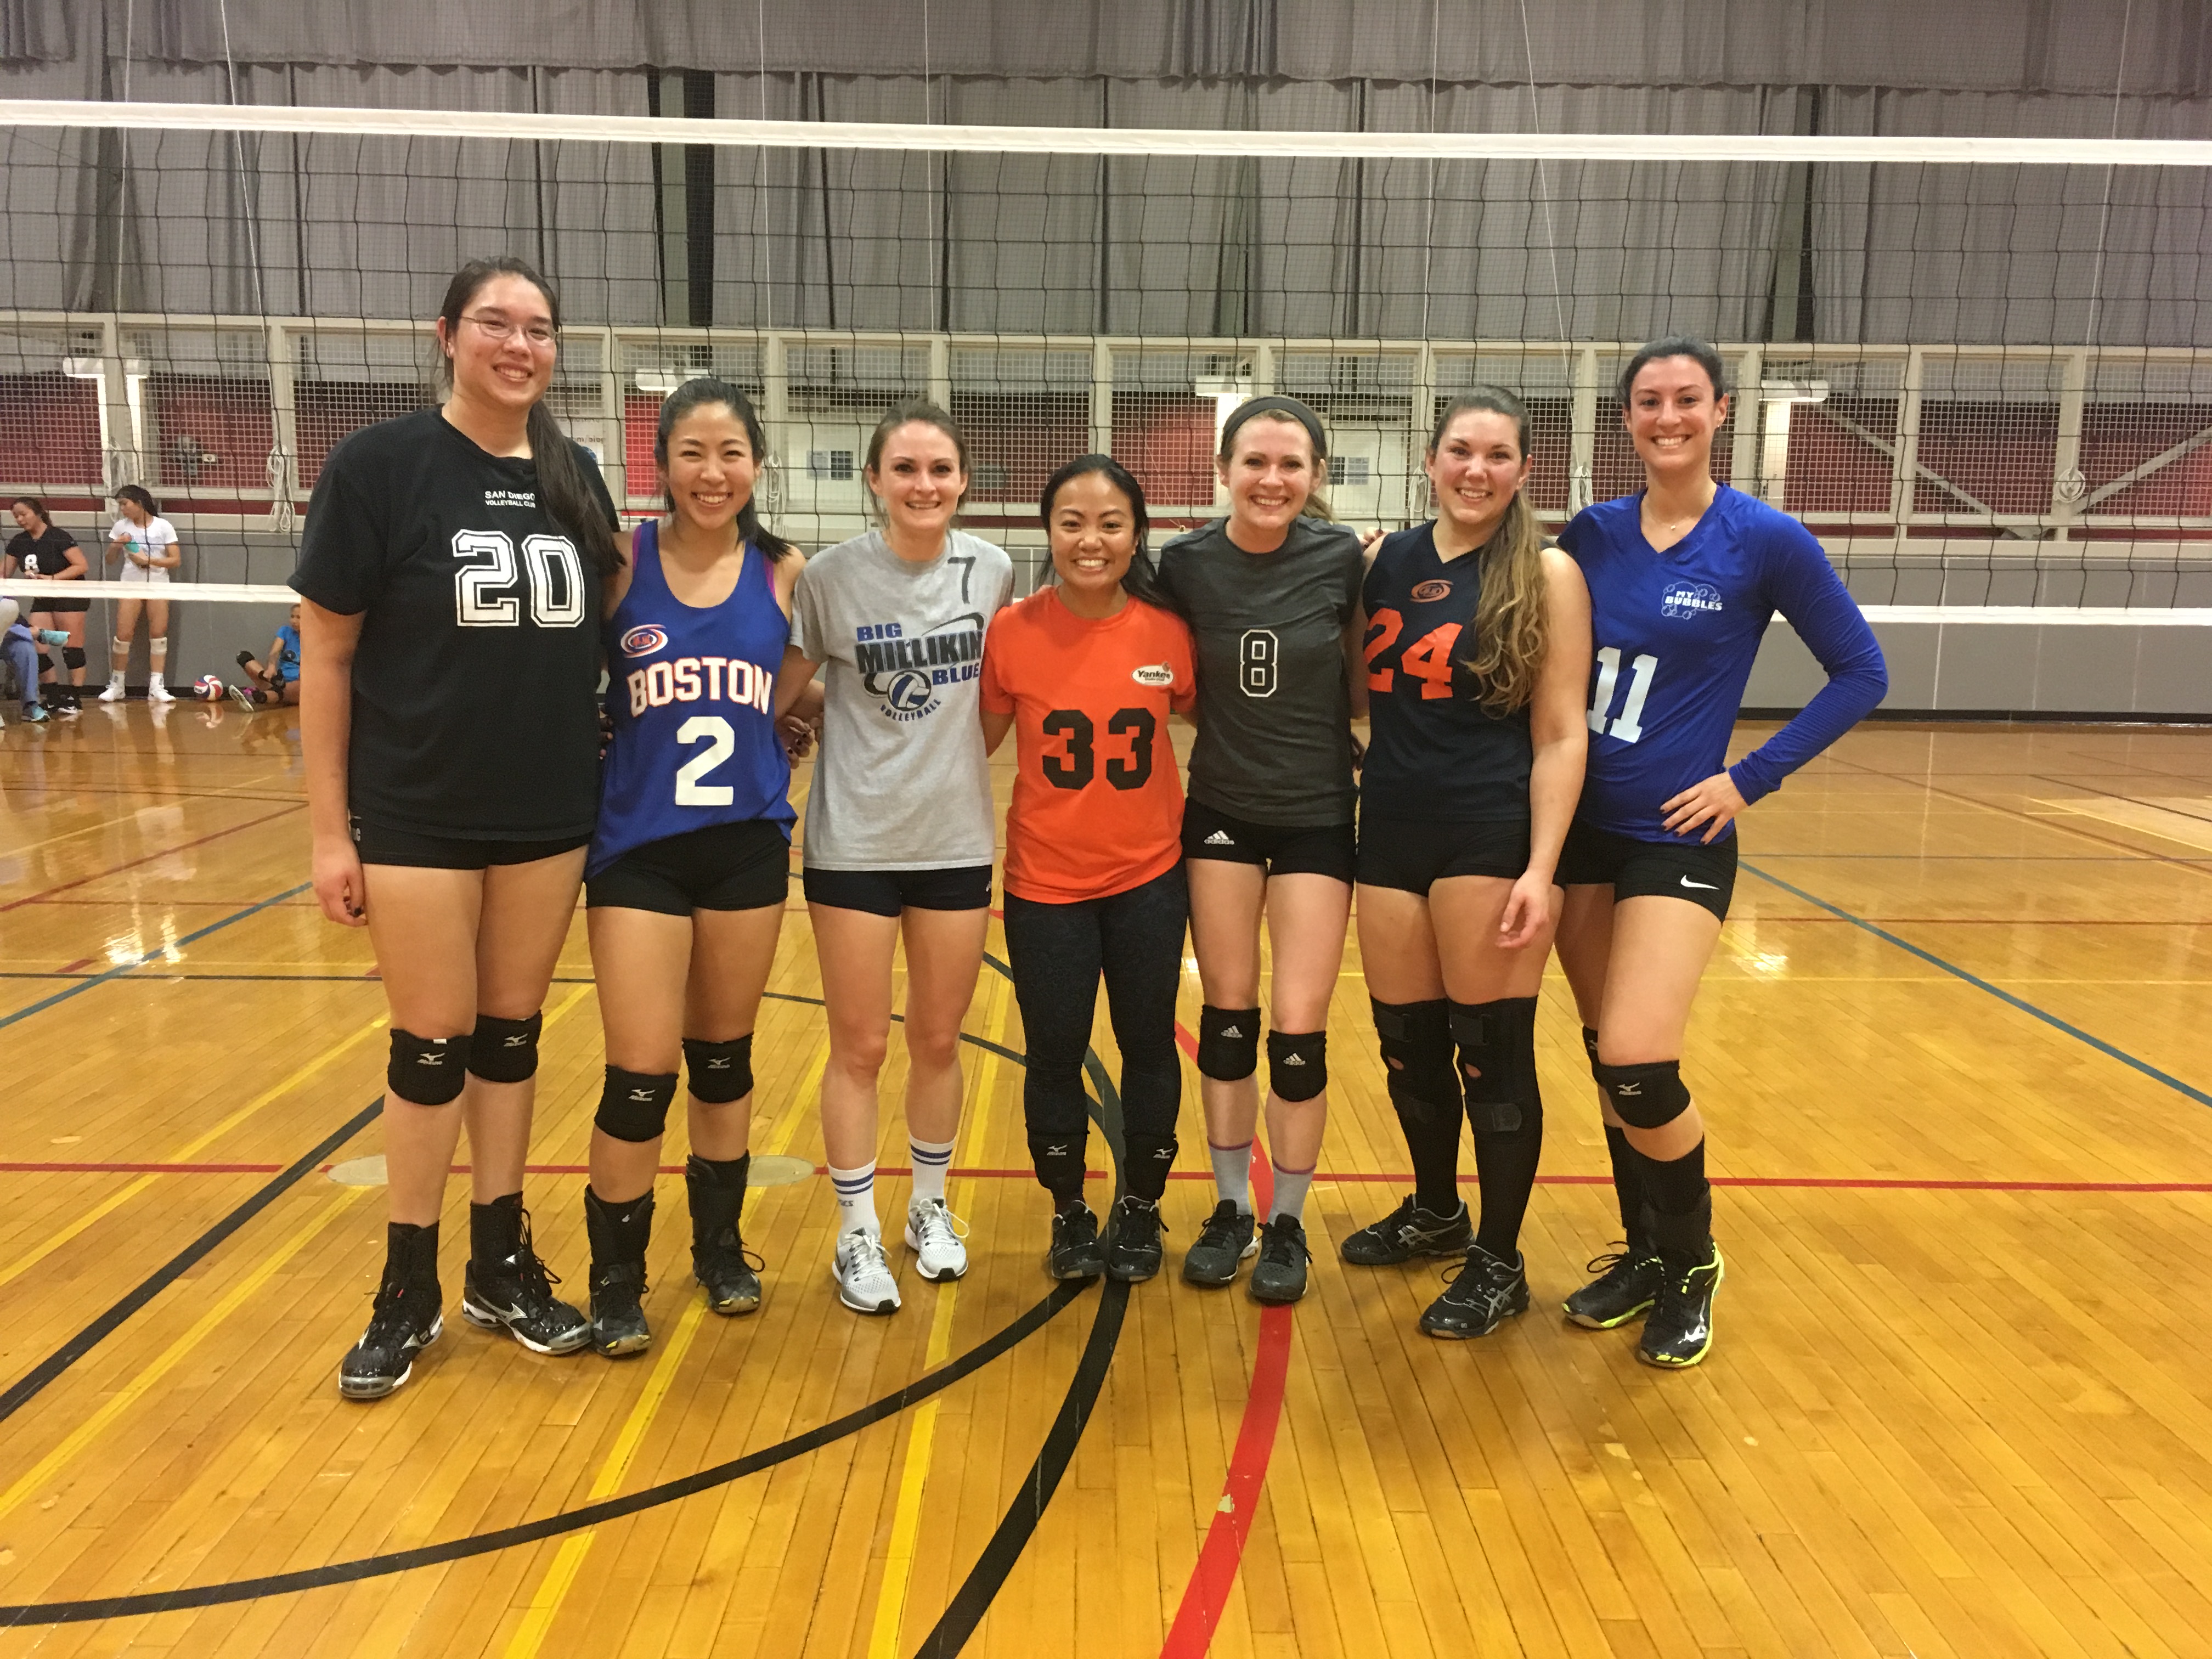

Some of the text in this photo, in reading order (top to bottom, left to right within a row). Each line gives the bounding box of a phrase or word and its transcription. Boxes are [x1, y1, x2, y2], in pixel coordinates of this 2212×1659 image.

[485, 490, 535, 500] SAN DIEGO
[452, 529, 585, 628] 20
[947, 556, 976, 604] 7
[1676, 590, 1694, 599] MY
[1665, 596, 1723, 611] BUBBLES
[854, 630, 983, 674] MILLIKIN
[856, 623, 902, 641] BIG
[1363, 608, 1463, 699] 24
[627, 657, 772, 716] BOSTON
[932, 662, 980, 685] BLUE
[1240, 629, 1277, 697] 8
[880, 698, 941, 721] VOLLEYBALL
[1586, 646, 1658, 743] 11
[675, 716, 735, 806] 2
[1042, 708, 1155, 791] 33
